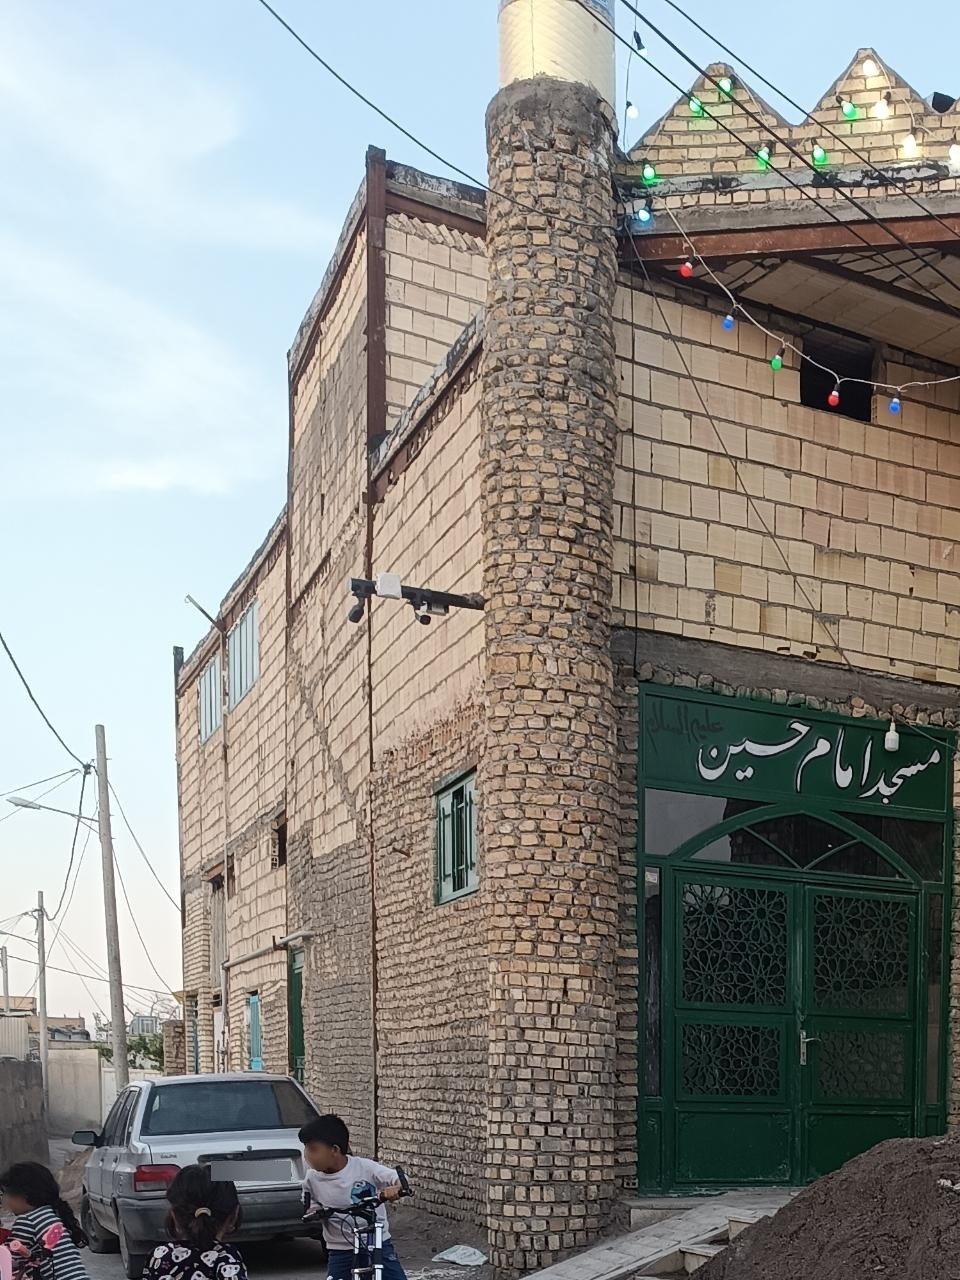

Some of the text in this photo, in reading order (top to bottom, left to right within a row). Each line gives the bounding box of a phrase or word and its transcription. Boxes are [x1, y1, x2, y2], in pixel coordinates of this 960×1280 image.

[697, 718, 812, 783] حسین
[796, 727, 873, 793] امام
[857, 748, 942, 805] مسجد
